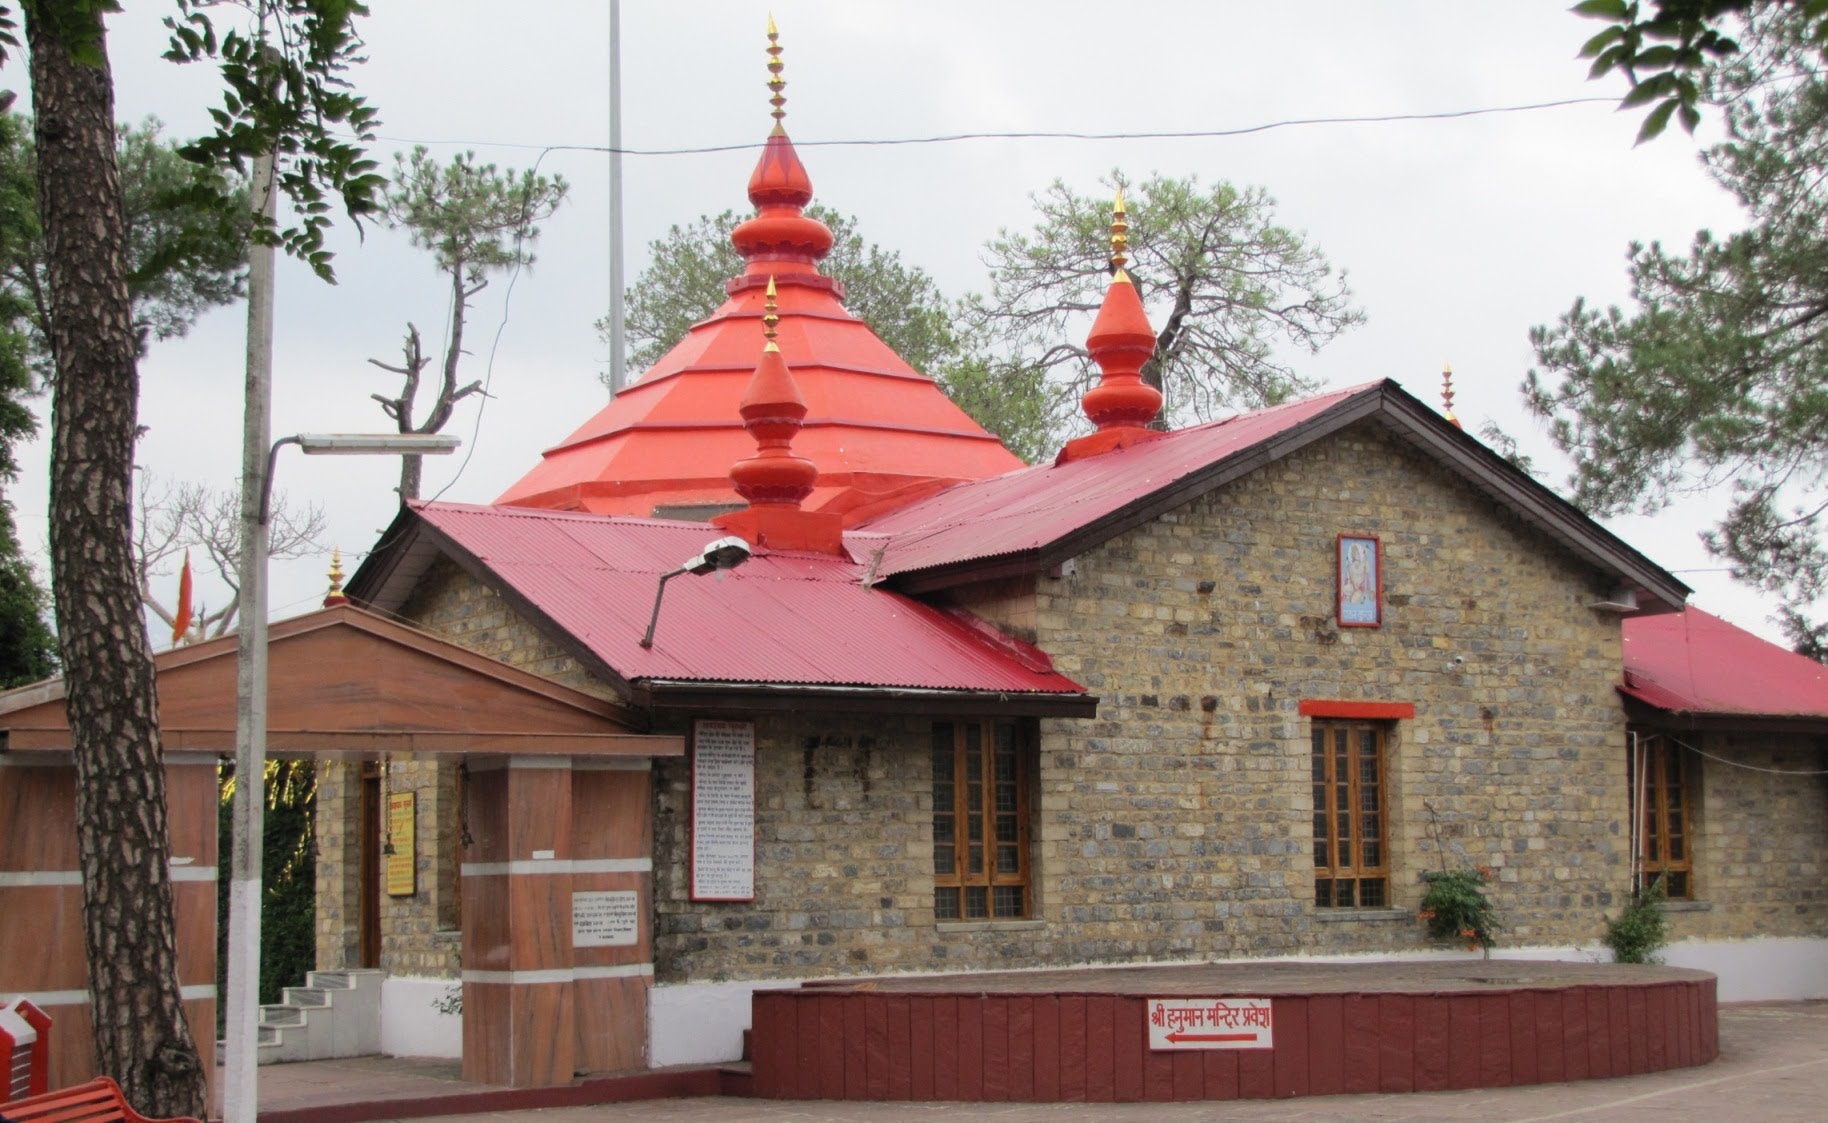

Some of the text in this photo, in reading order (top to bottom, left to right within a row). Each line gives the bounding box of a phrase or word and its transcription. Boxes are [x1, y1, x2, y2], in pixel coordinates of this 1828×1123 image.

[1151, 1002, 1270, 1033] श्री हनुमान मन्दिर प्रवेश
